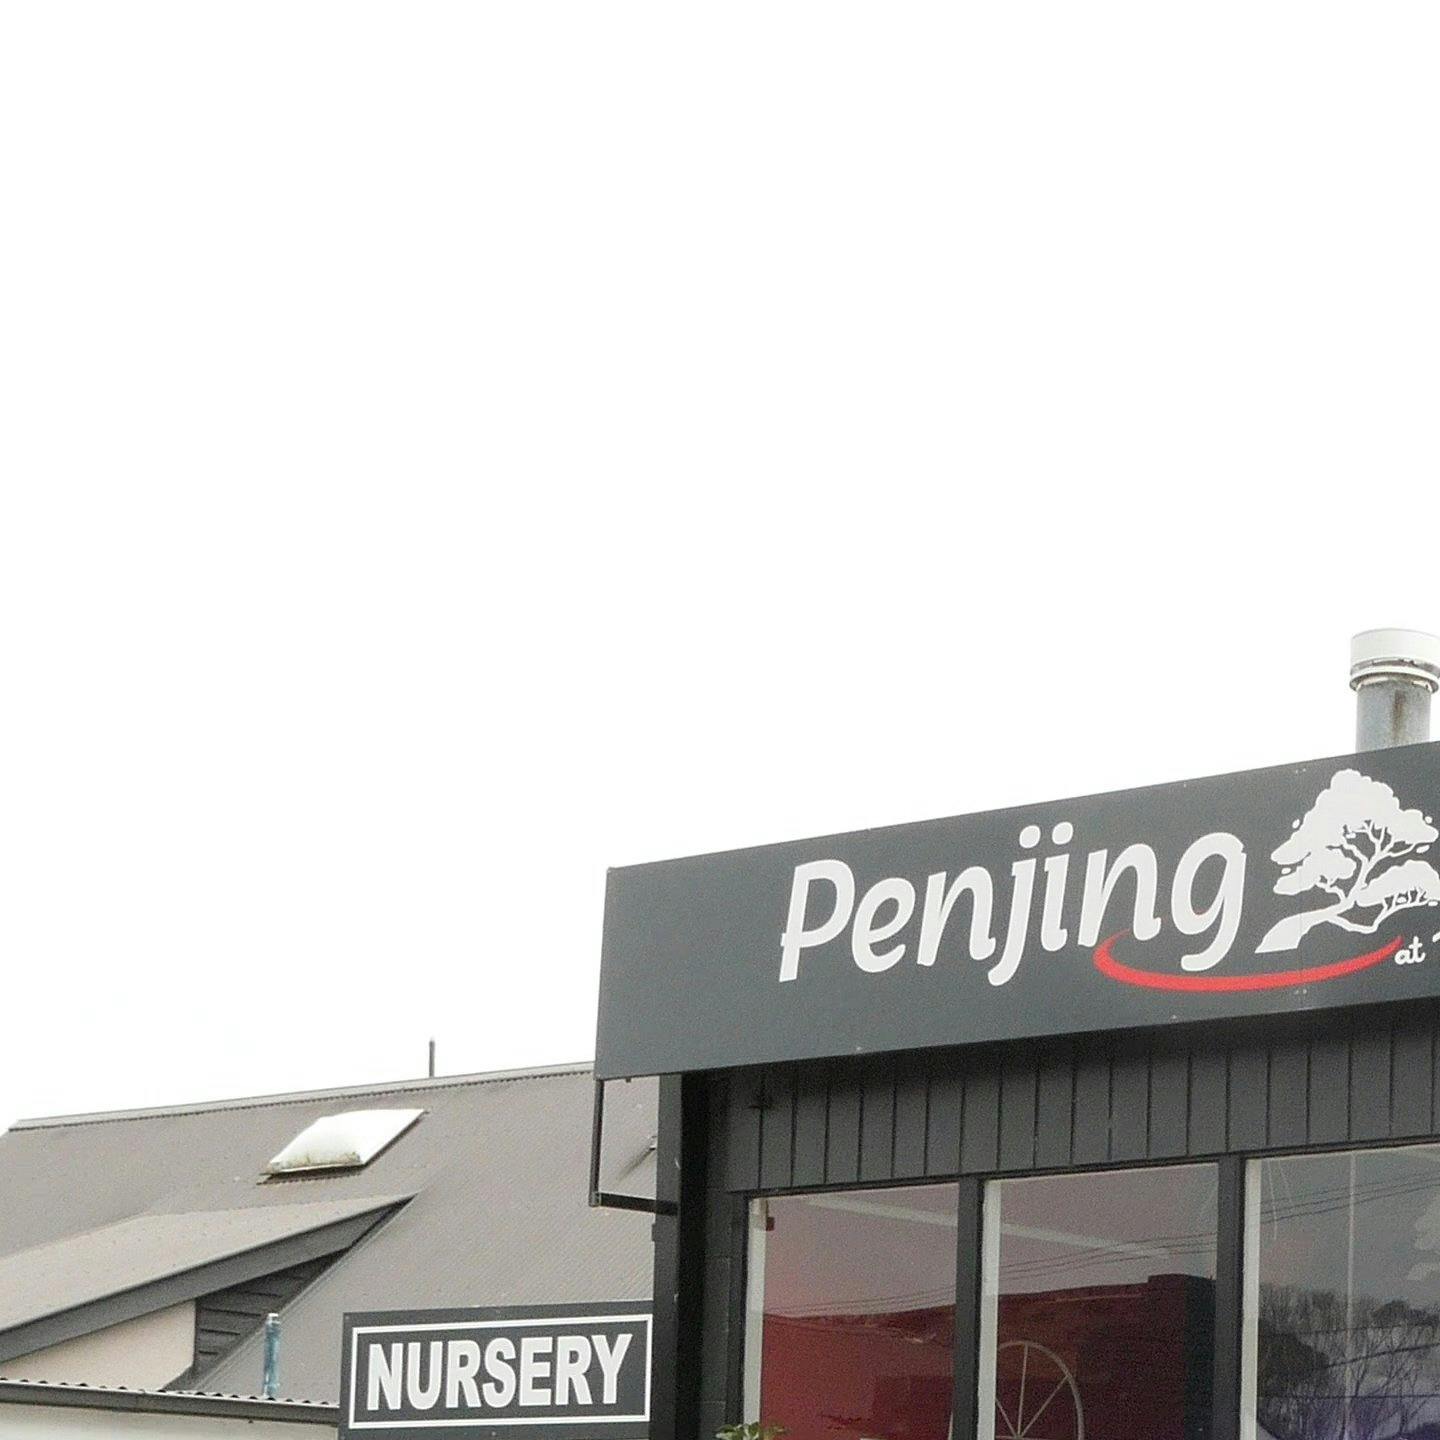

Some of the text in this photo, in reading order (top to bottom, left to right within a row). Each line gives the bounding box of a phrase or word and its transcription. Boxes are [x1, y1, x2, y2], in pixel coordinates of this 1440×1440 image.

[779, 821, 1247, 987] Penjing
[1394, 937, 1426, 966] at
[367, 1333, 633, 1410] NURSERY
